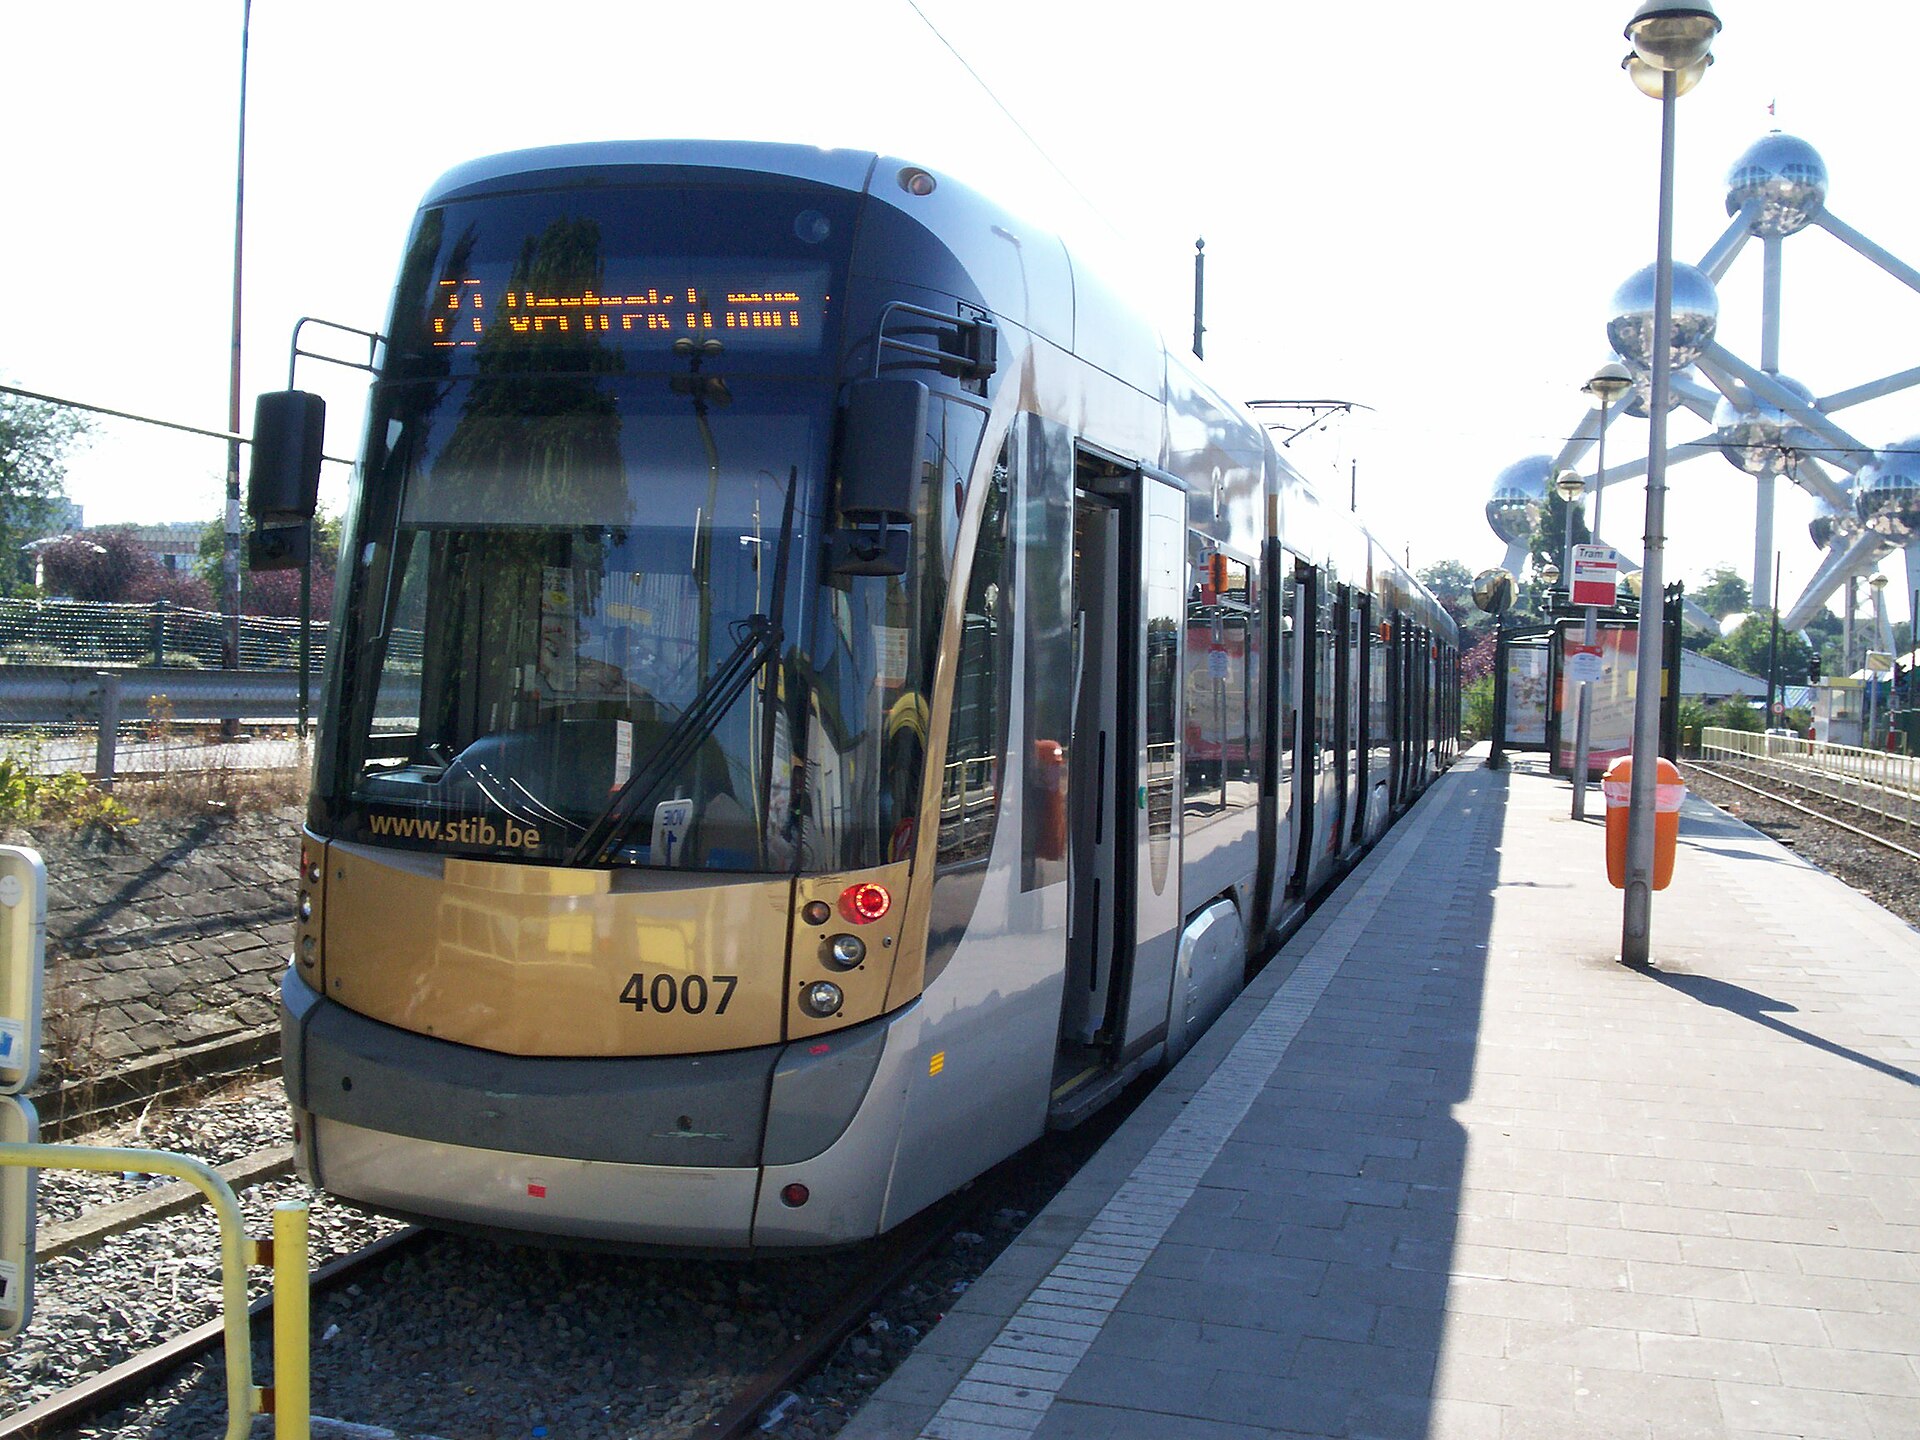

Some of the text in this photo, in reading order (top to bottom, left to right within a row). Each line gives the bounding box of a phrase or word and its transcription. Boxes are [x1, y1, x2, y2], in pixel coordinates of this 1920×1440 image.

[1579, 547, 1604, 559] Tram
[369, 813, 541, 850] www.stib.be
[618, 972, 739, 1016] 4007
